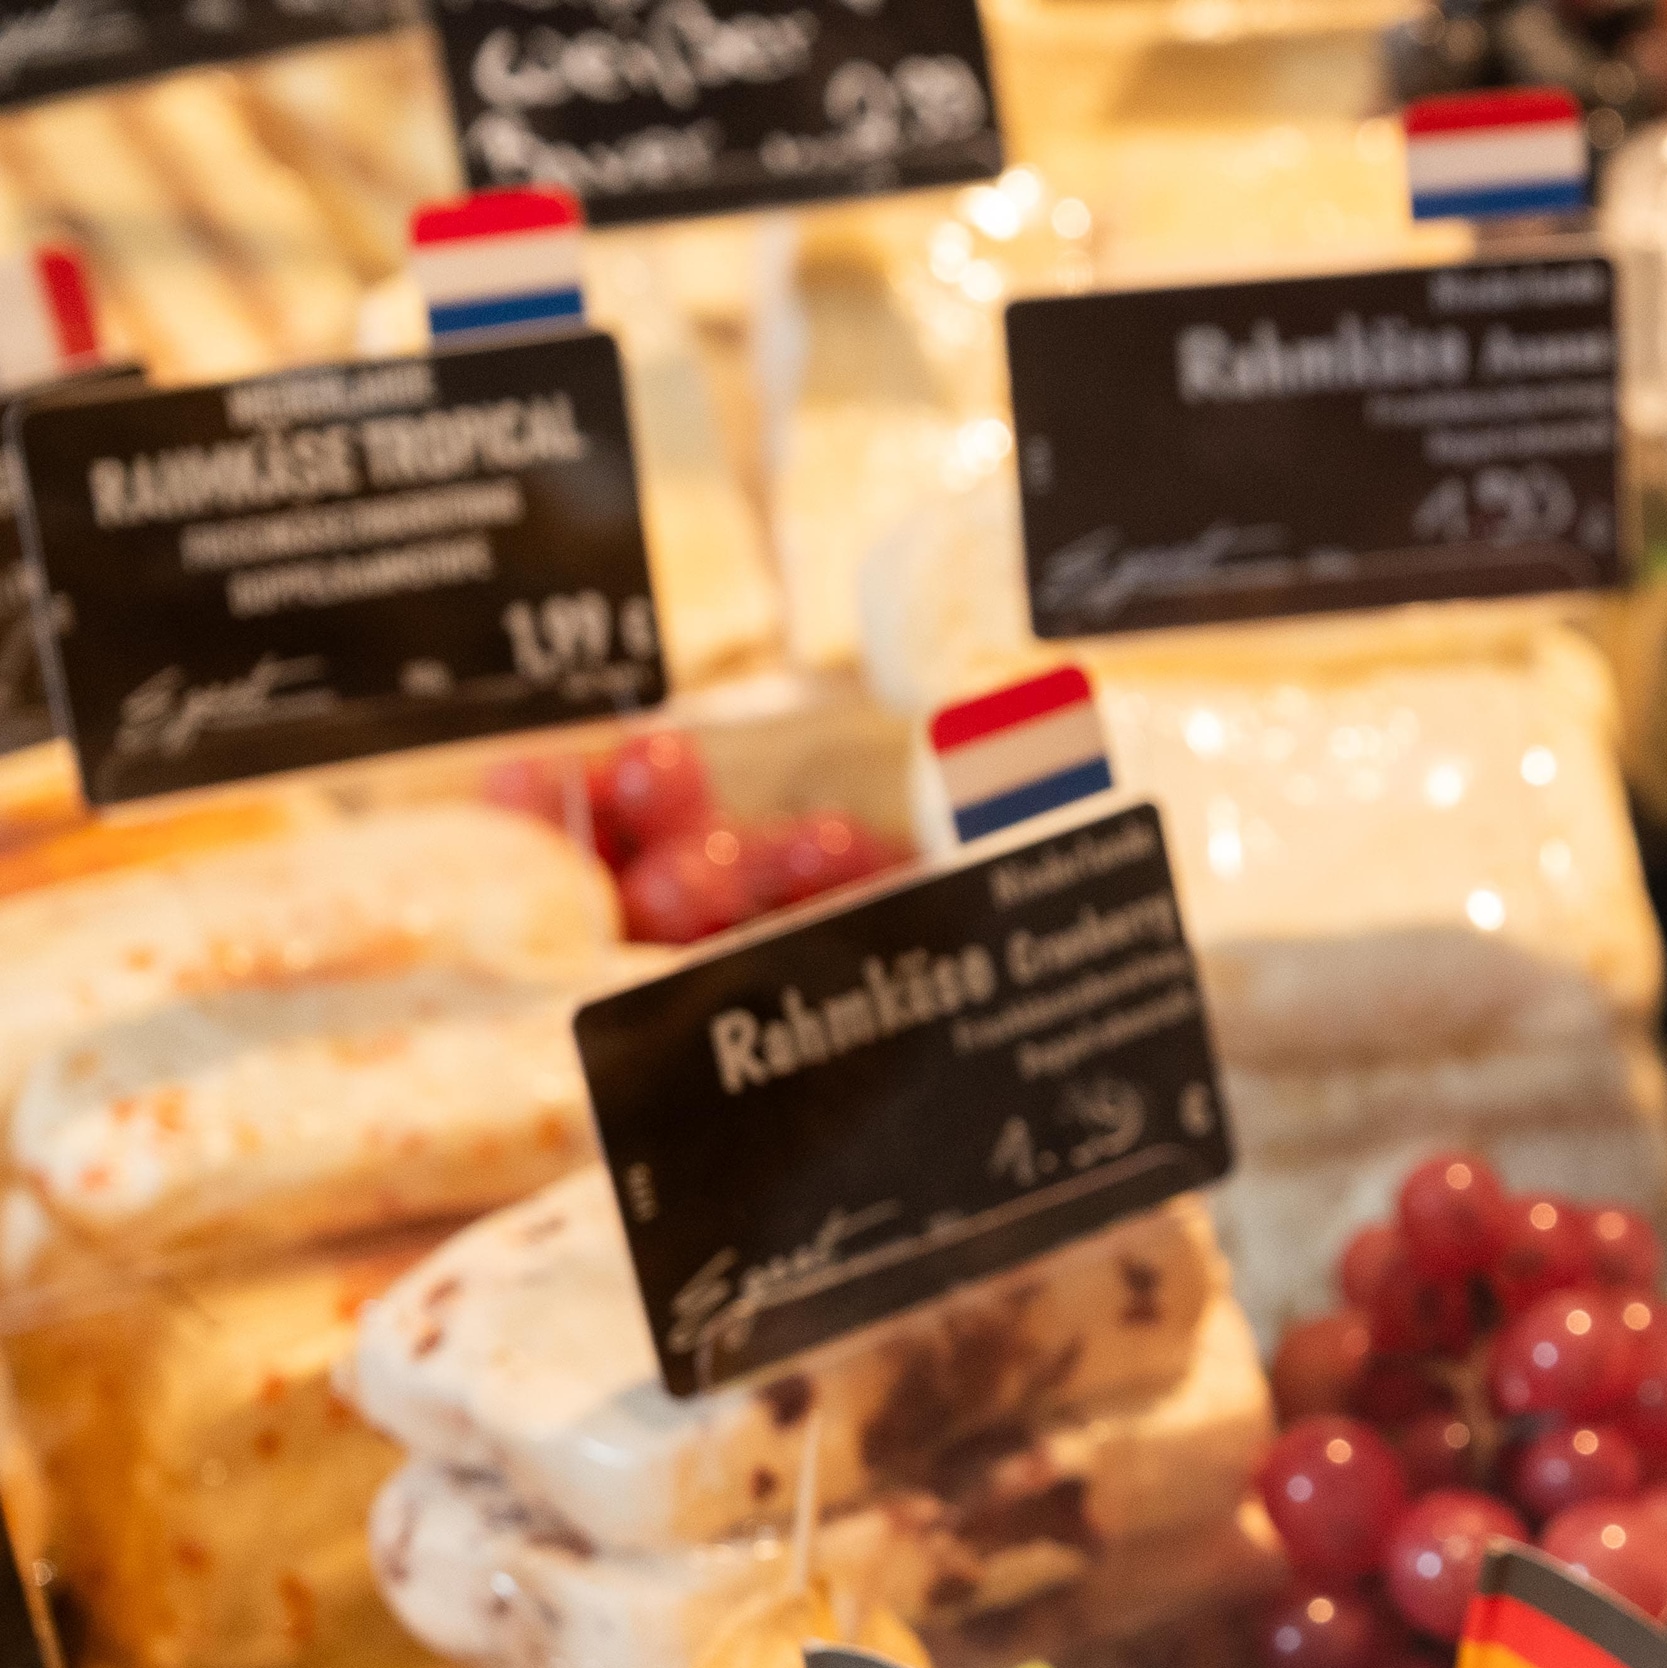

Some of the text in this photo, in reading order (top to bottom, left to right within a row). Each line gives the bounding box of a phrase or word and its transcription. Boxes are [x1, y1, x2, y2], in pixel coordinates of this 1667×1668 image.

[89, 394, 585, 527] RAHMKÄSE TROPICAL
[712, 945, 997, 1095] Rahmkäse
